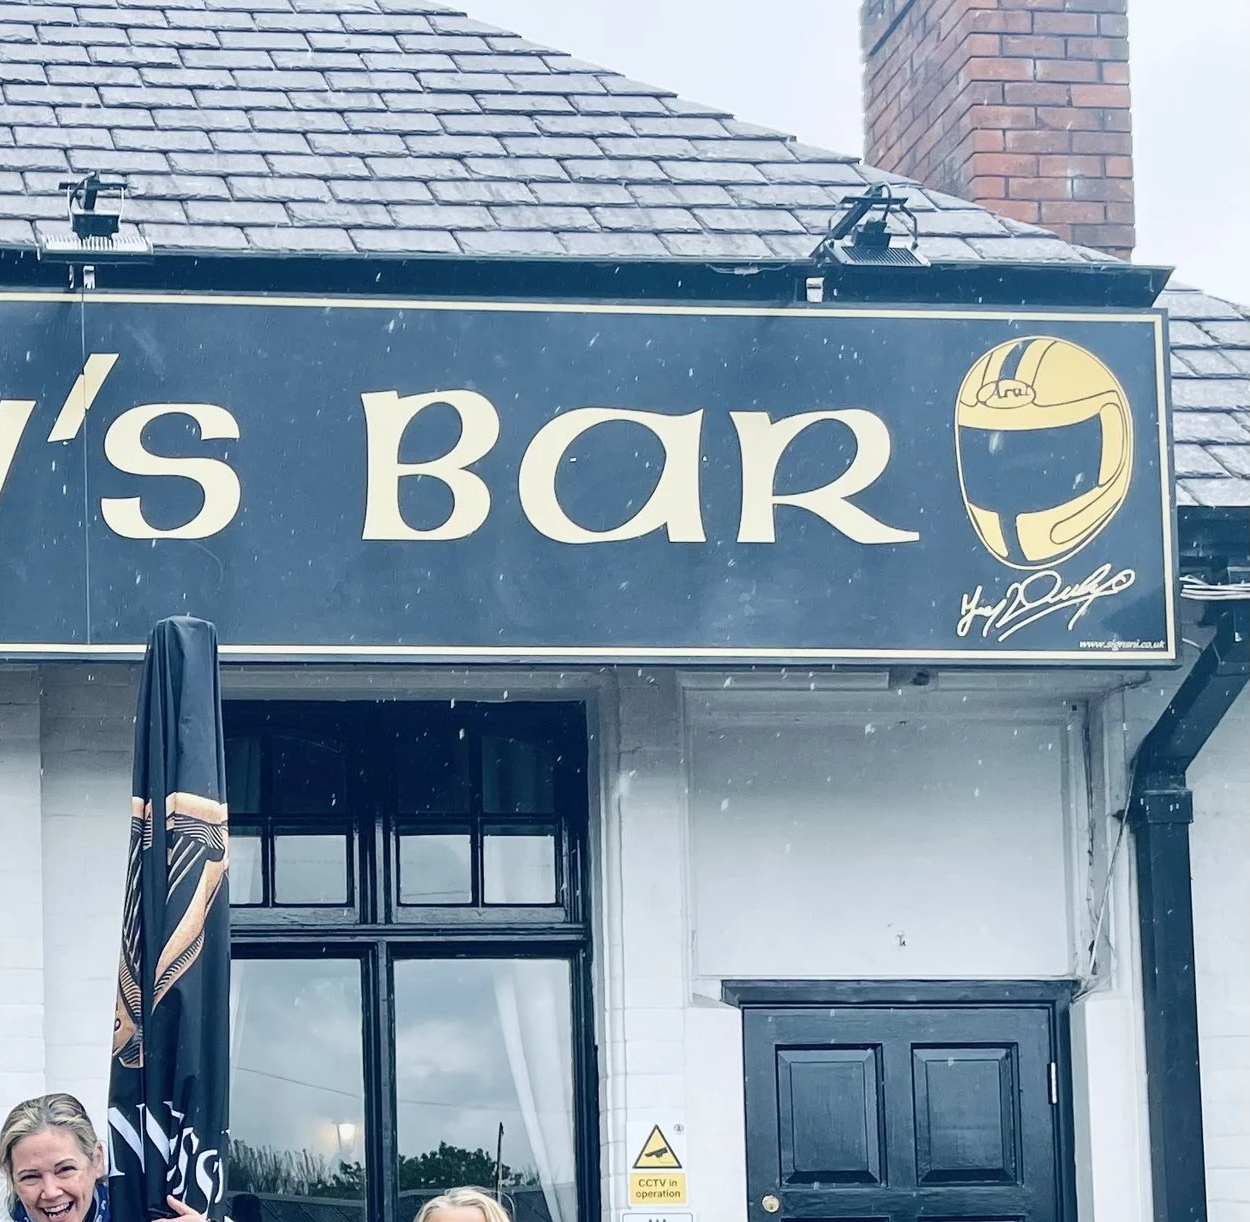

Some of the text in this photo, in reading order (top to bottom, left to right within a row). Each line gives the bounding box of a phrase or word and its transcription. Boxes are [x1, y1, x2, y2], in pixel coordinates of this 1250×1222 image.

[638, 1179, 678, 1188] CCTV in
[635, 1189, 681, 1199] operation
